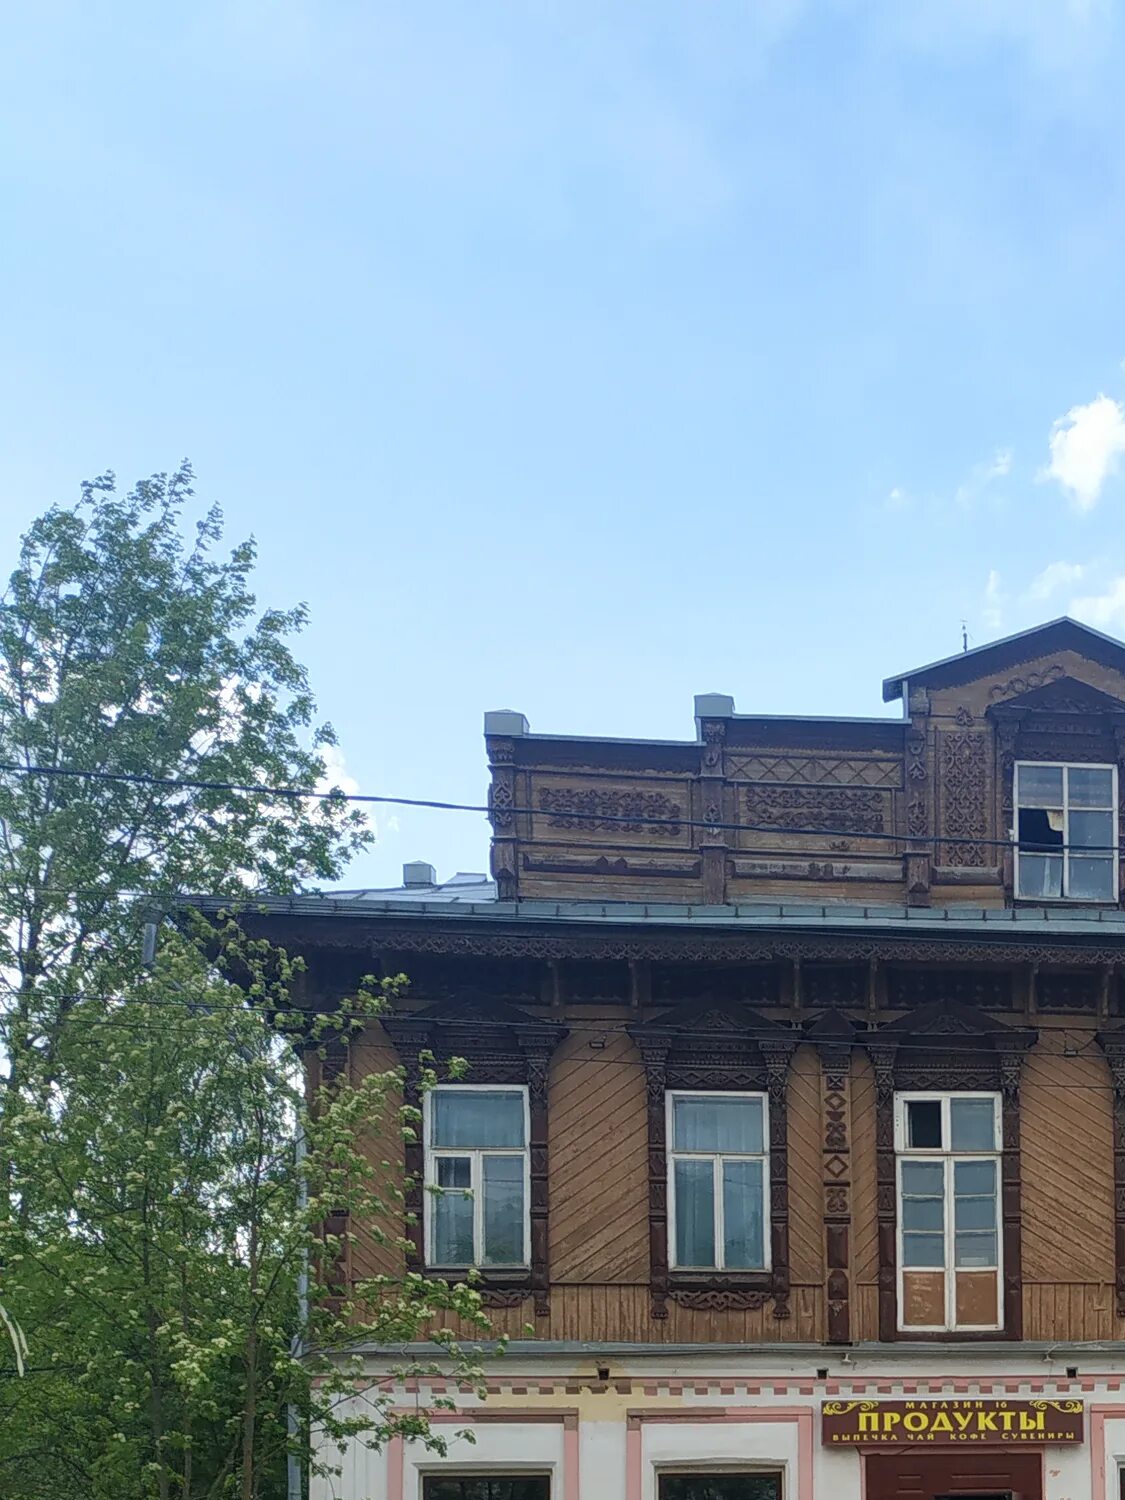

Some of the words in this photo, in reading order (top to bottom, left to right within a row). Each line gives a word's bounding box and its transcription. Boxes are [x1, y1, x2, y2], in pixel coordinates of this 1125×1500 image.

[905, 1401, 983, 1409] МАГАЗИН
[995, 1401, 1008, 1409] 16
[858, 1411, 1045, 1432] ПРОДУКТЫ
[906, 1432, 935, 1441] ЧАЙ
[1001, 1432, 1075, 1440] СУВЕНИРЫ
